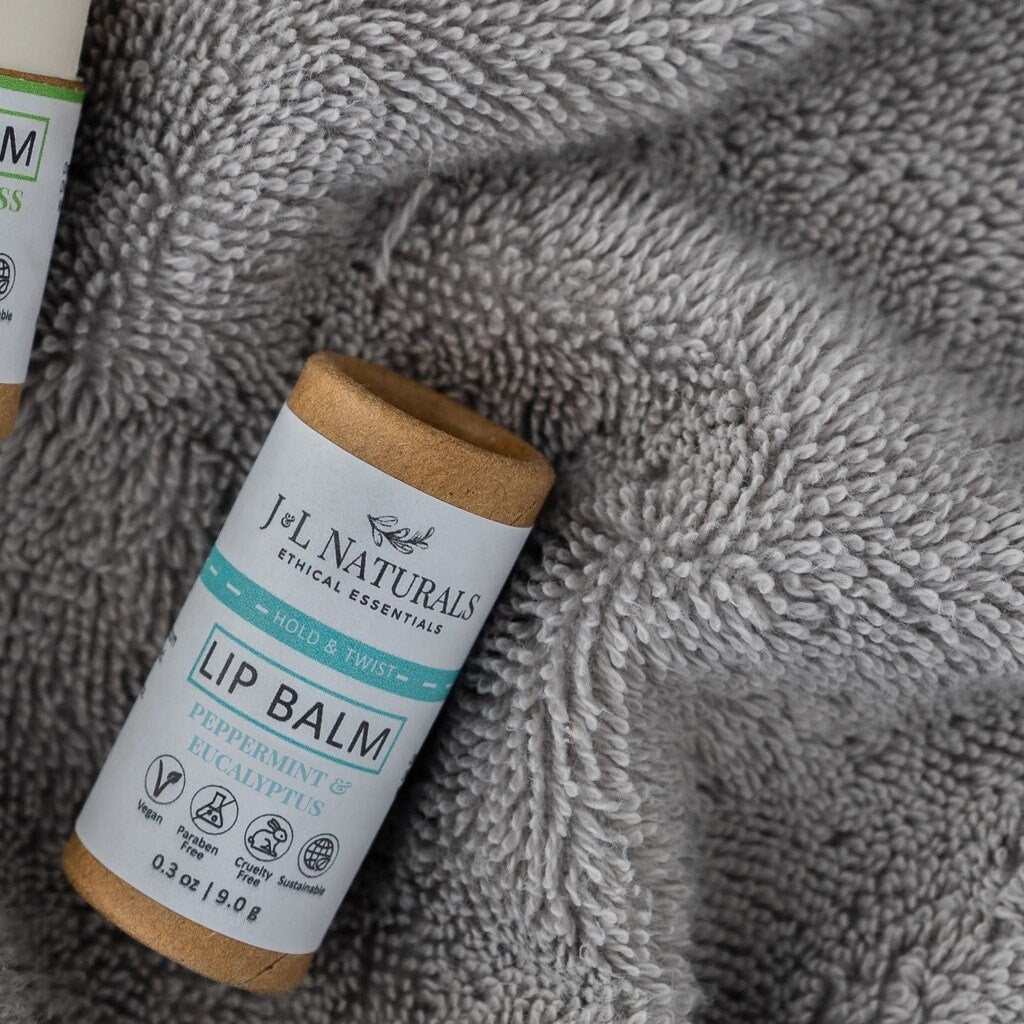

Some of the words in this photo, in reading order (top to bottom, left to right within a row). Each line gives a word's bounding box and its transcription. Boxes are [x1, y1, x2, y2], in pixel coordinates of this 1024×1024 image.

[260, 494, 311, 550] J&L
[317, 527, 481, 621] NATURALS
[277, 548, 340, 593] ETHICAL
[348, 590, 443, 635] ESSENTIALS
[273, 611, 320, 645] HOLD
[324, 640, 337, 655] &
[344, 647, 396, 677] TWIST
[198, 640, 258, 694] LIP
[266, 683, 391, 761] BALM
[187, 701, 328, 789] PEPPERMINT
[329, 778, 353, 796] &
[187, 735, 326, 817] EUCALYPTUS
[137, 799, 163, 824] Vegan
[177, 826, 219, 855] Paraben
[180, 840, 204, 861] Free
[235, 856, 273, 881] Cruelty
[236, 871, 260, 887] Free
[152, 854, 179, 878] 0.3
[180, 874, 201, 891] oz
[215, 889, 246, 912] 9.0
[247, 905, 261, 922] g
[278, 875, 325, 897] Sustainable
